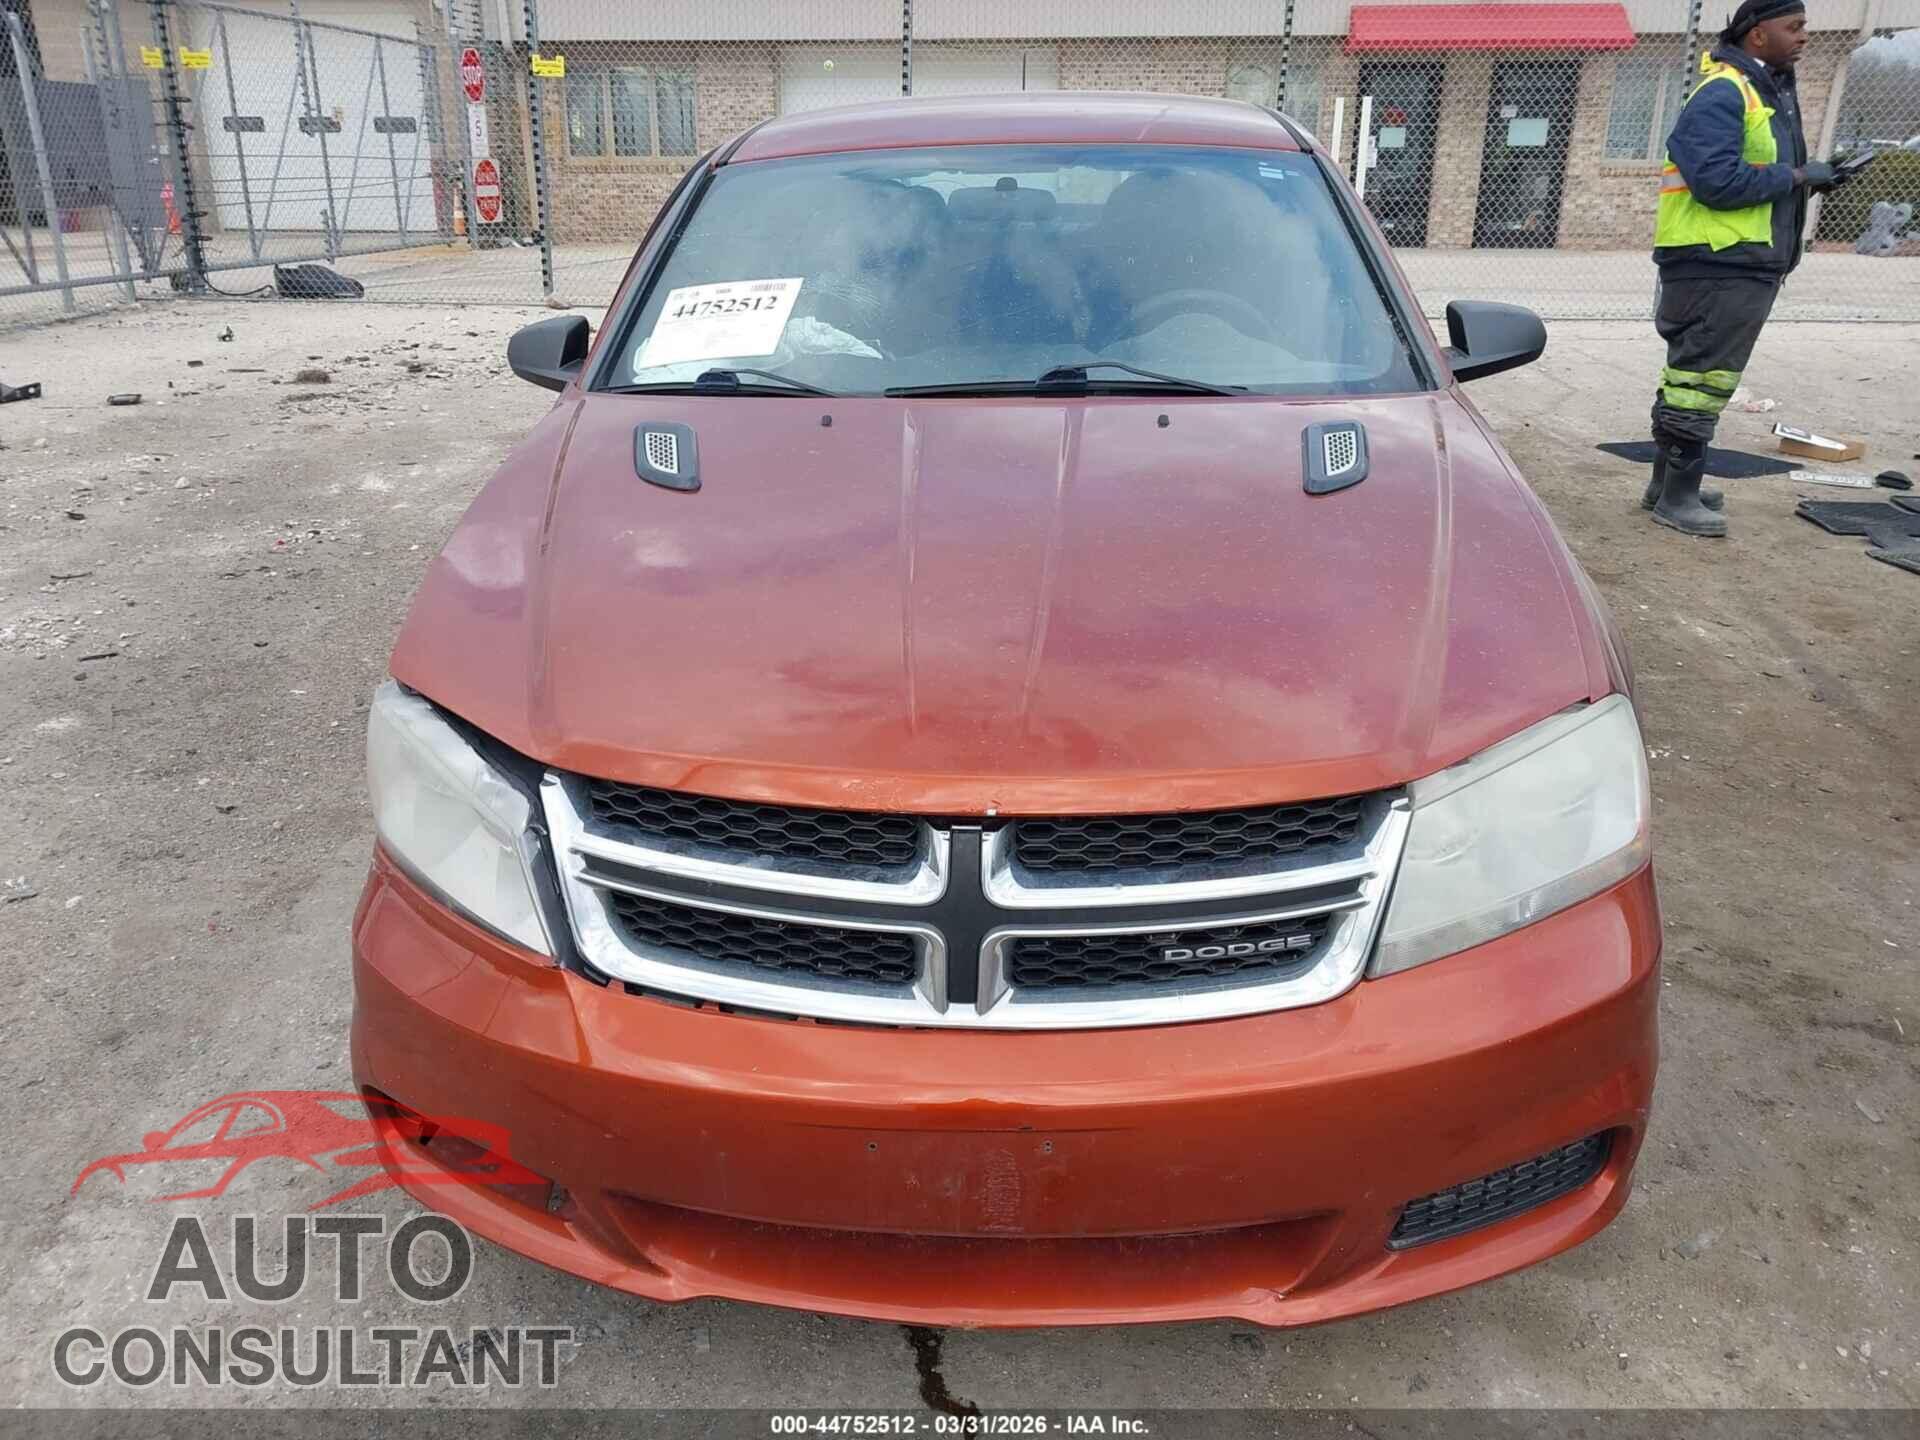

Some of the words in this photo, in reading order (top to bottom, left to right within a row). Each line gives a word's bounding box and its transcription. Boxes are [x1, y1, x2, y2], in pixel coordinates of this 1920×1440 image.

[463, 65, 481, 85] STOP
[479, 199, 497, 210] ENTER
[672, 296, 778, 318] 44752512
[1164, 934, 1312, 961] DODGE
